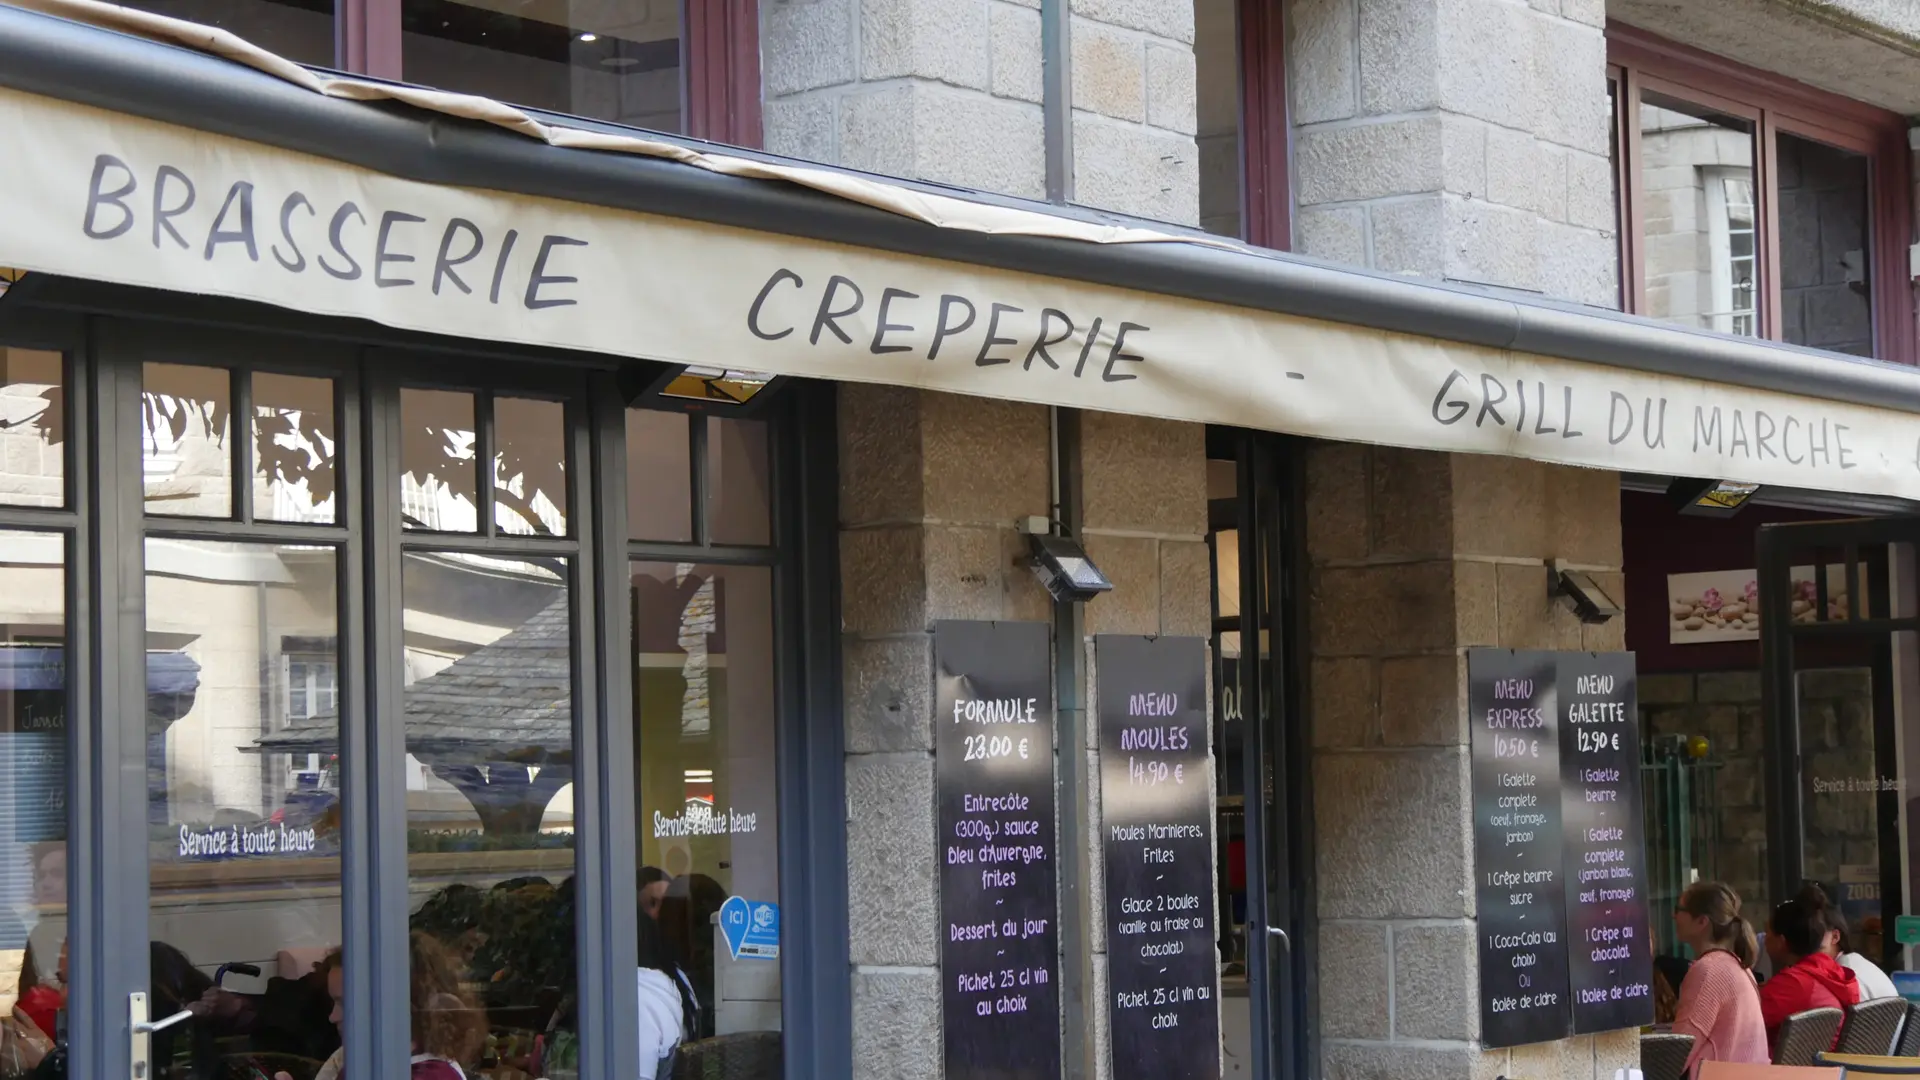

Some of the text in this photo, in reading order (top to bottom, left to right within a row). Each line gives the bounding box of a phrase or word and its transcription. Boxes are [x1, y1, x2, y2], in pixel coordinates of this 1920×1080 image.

[83, 154, 588, 309] BRASSERIE
[747, 268, 1150, 383] CREPERIE
[1431, 369, 1583, 438] GRILL
[1608, 390, 1667, 449] DU
[1692, 405, 1857, 469] MARCHE
[1494, 678, 1534, 700] MENU
[1577, 674, 1614, 695] MENU
[953, 698, 1037, 725] FORMULE
[1129, 692, 1178, 716] MENU
[1569, 702, 1625, 724] GALETTE
[1486, 707, 1544, 730] EXPRESS
[1120, 726, 1189, 751] MOULES
[1494, 734, 1539, 759] 10.50 €
[1577, 727, 1620, 753] 12.90 €
[964, 735, 1029, 762] 23.00 €
[1129, 756, 1184, 786] 14.90 €
[1503, 772, 1536, 787] Galette
[1586, 767, 1620, 783] Galette
[1813, 776, 1846, 793] Service
[1856, 777, 1879, 792] toute
[1882, 775, 1906, 791] heu
[964, 792, 1029, 813] Entrecôte
[1585, 788, 1616, 802] beurre
[654, 809, 690, 838] Service
[701, 811, 727, 835] toute
[729, 807, 757, 833] heure
[1004, 820, 1039, 835] sauce
[180, 822, 315, 856] Service à toute heure
[1111, 824, 1145, 841] Moules
[1505, 831, 1534, 847] jambon)
[1589, 827, 1623, 842] Galette
[948, 846, 974, 864] Bleu
[1143, 847, 1174, 864] Frites
[982, 869, 1016, 890] frites
[1493, 870, 1520, 888] Crêpe
[1523, 870, 1553, 884] beurre
[1578, 867, 1609, 884] (jambon
[1121, 893, 1199, 914] Glace 2 boules
[1509, 892, 1533, 906] sucre
[1600, 887, 1634, 902] fromage)
[729, 910, 743, 925] ICI
[1118, 917, 1204, 935] (vanille ou fraise ou
[951, 918, 1048, 941] Dessert du jour
[1622, 926, 1633, 938] au
[1140, 940, 1184, 957] chocolat)
[1494, 931, 1541, 949] Coca-Cola
[1543, 930, 1557, 944] (au
[1511, 954, 1536, 968] choix)
[1591, 944, 1631, 962] chocolat
[958, 967, 1048, 992] Pichet 25 cl vin
[1518, 973, 1531, 988] Ou
[1117, 985, 1210, 1009] Pichet 25 cl vin au
[1492, 992, 1557, 1012] Bolée de cidre
[1582, 987, 1607, 1004] Bolée
[1610, 985, 1622, 999] de
[1625, 982, 1648, 998] cidre
[977, 994, 1027, 1016] au choix
[1152, 1012, 1178, 1029] choix
